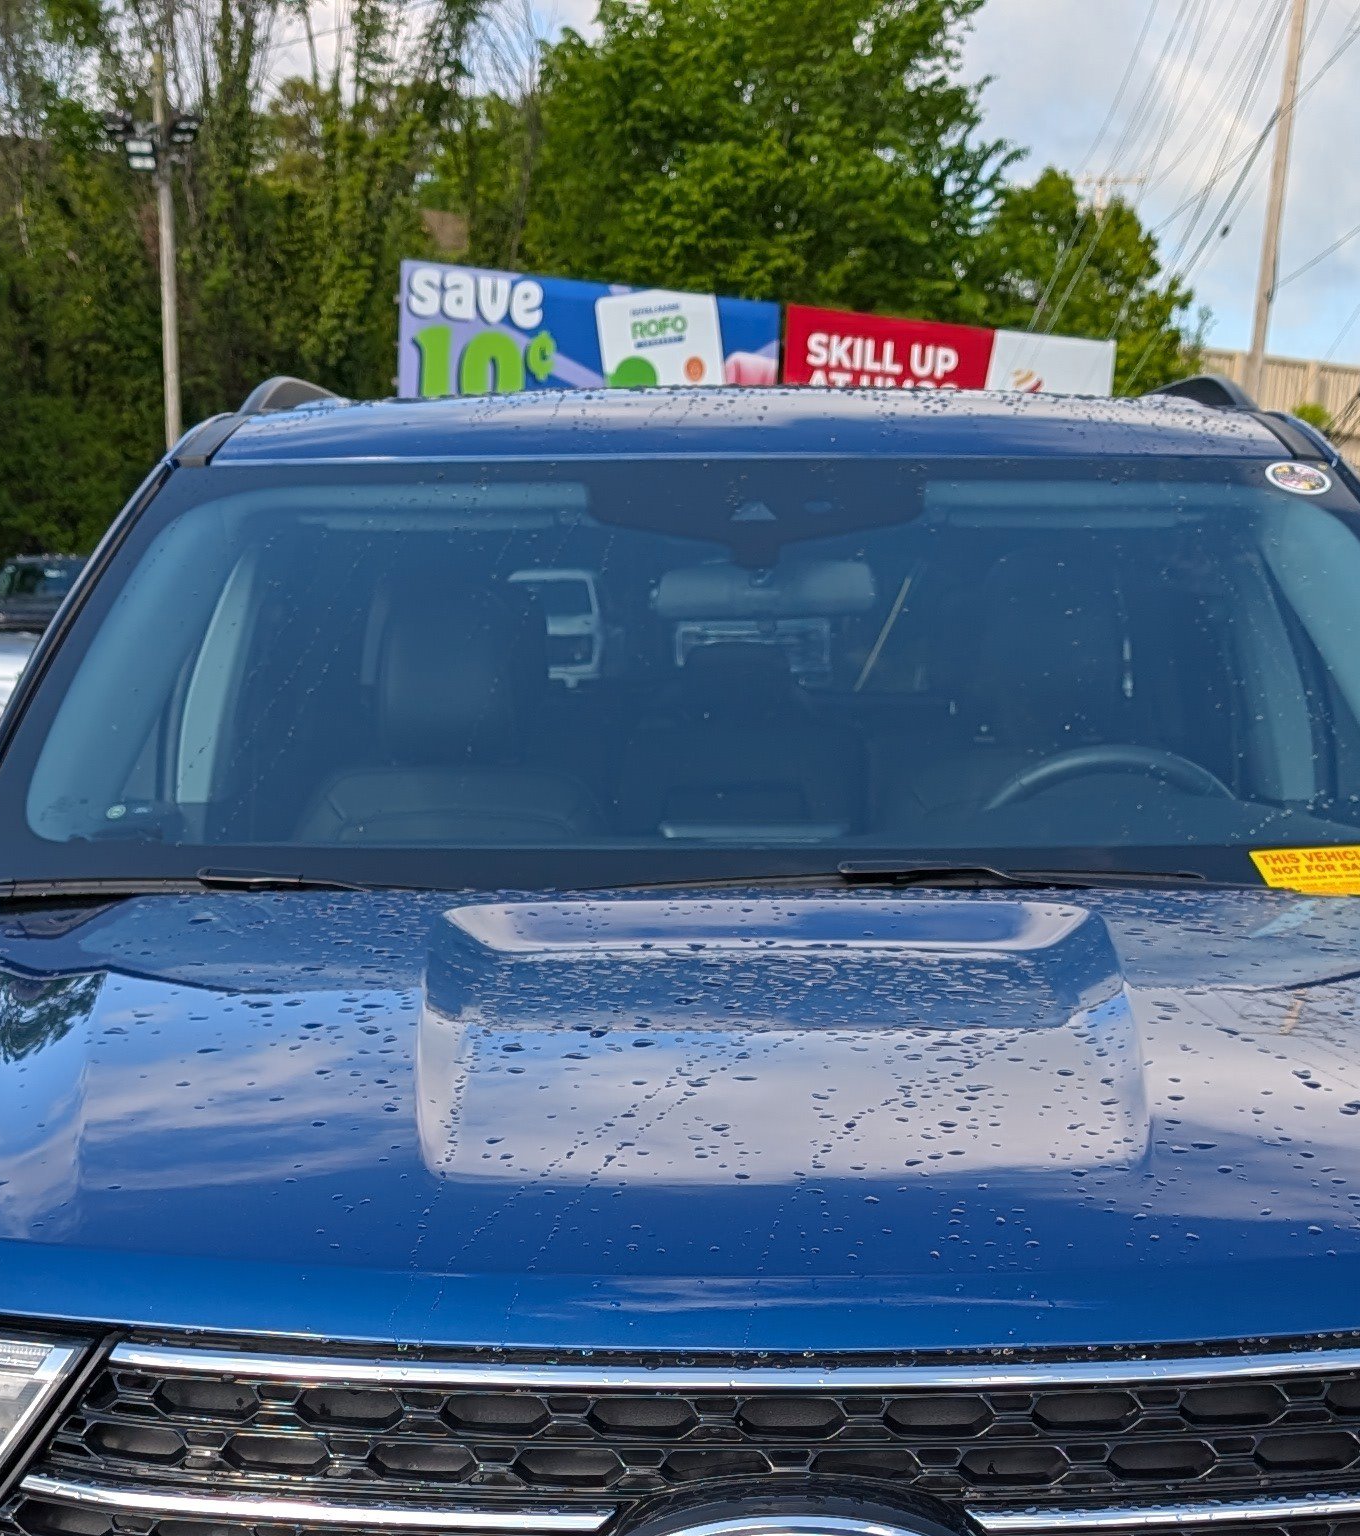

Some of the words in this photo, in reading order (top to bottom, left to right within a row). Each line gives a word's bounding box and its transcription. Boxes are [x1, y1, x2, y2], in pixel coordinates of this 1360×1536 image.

[408, 268, 544, 330] save
[630, 315, 688, 340] ROFO
[806, 332, 903, 375] SKILL
[909, 342, 959, 378] UP
[1258, 853, 1300, 866] THIS
[1271, 865, 1301, 875] NOT
[1305, 864, 1337, 873] FOR
